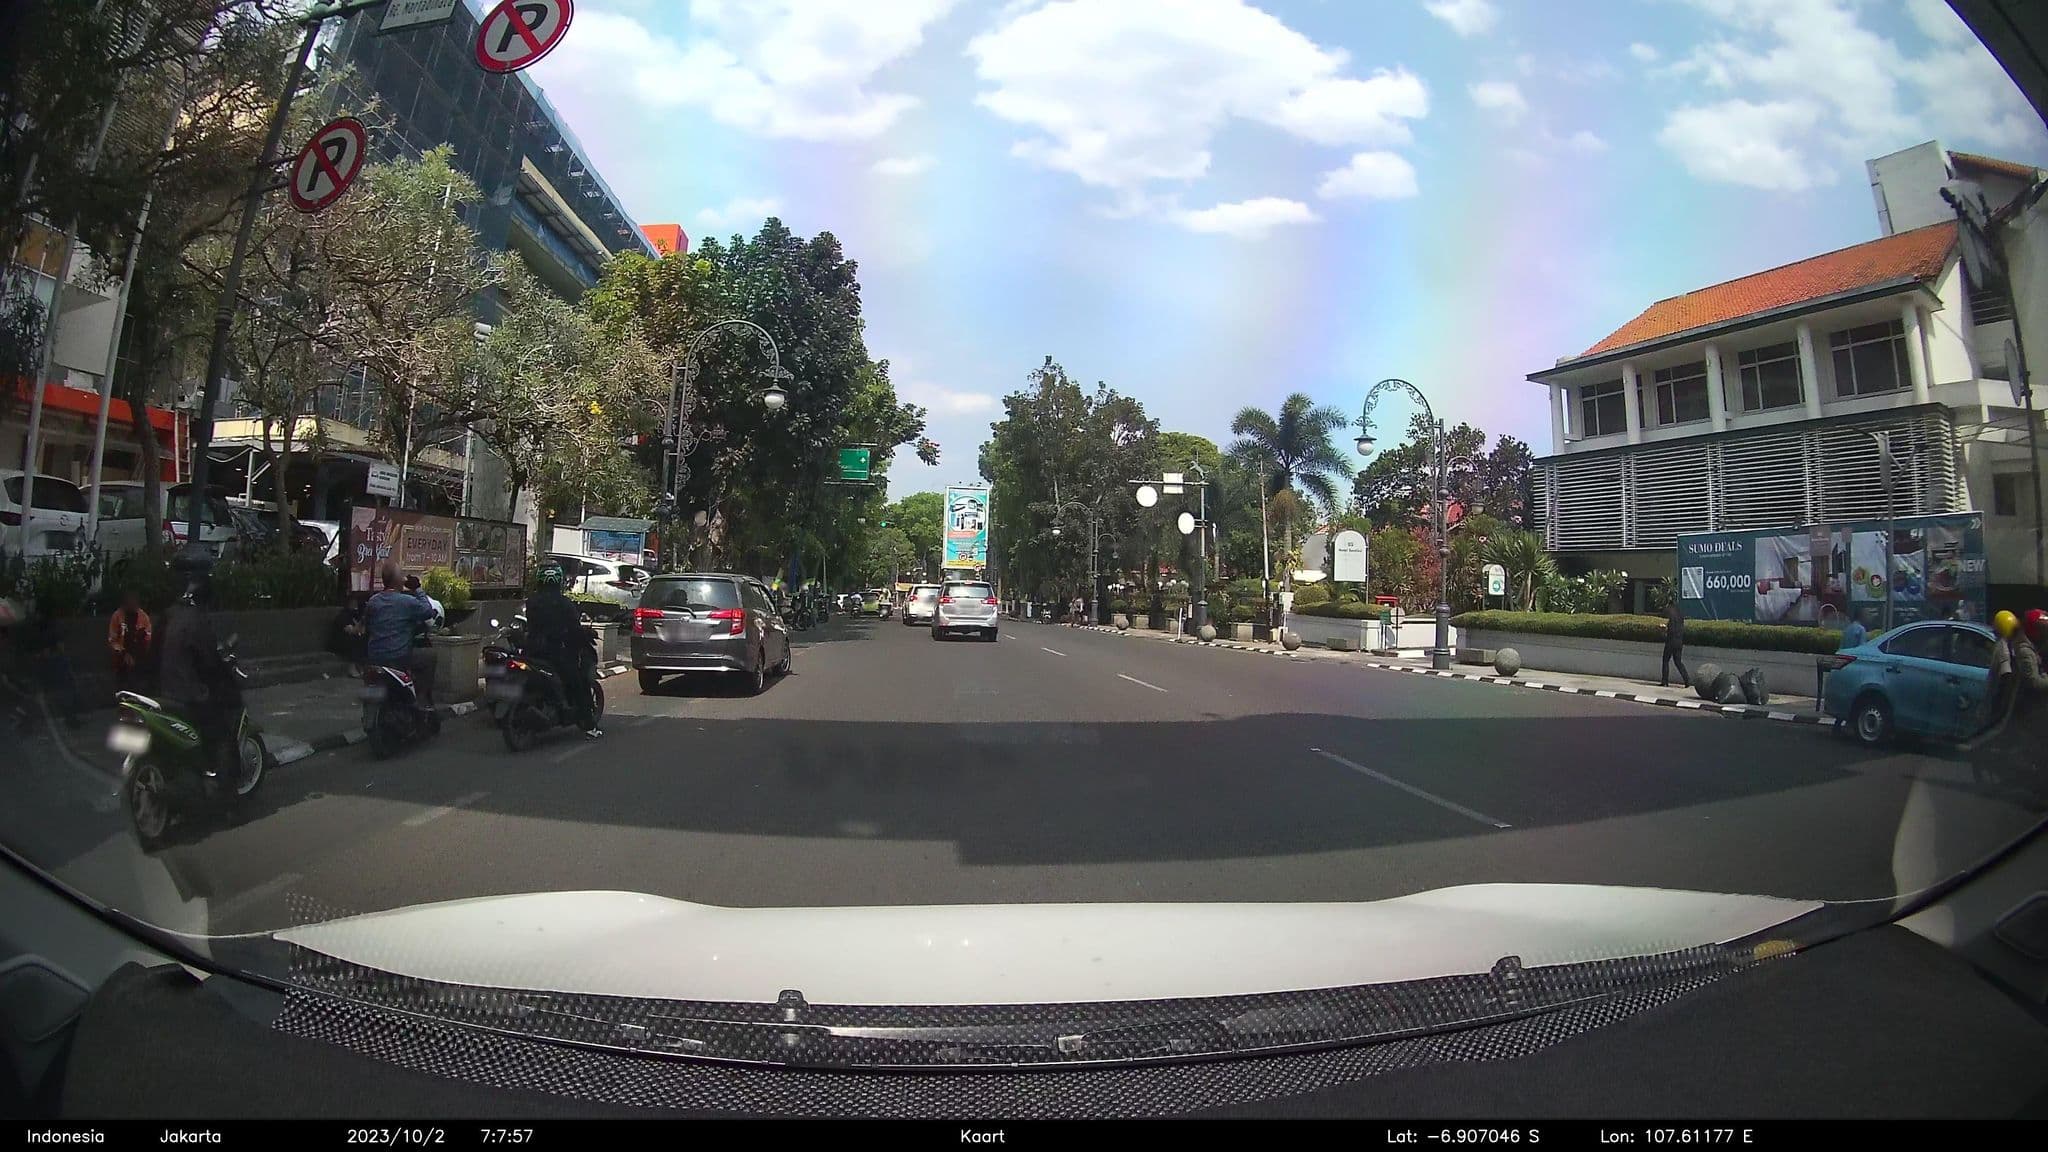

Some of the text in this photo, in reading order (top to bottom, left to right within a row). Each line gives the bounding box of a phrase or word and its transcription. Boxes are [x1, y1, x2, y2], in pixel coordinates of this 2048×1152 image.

[407, 537, 448, 550] EVERYDAY
[1689, 541, 1742, 554] SUMO DEALS
[437, 554, 448, 563] AM
[1706, 575, 1751, 591] 660,000
